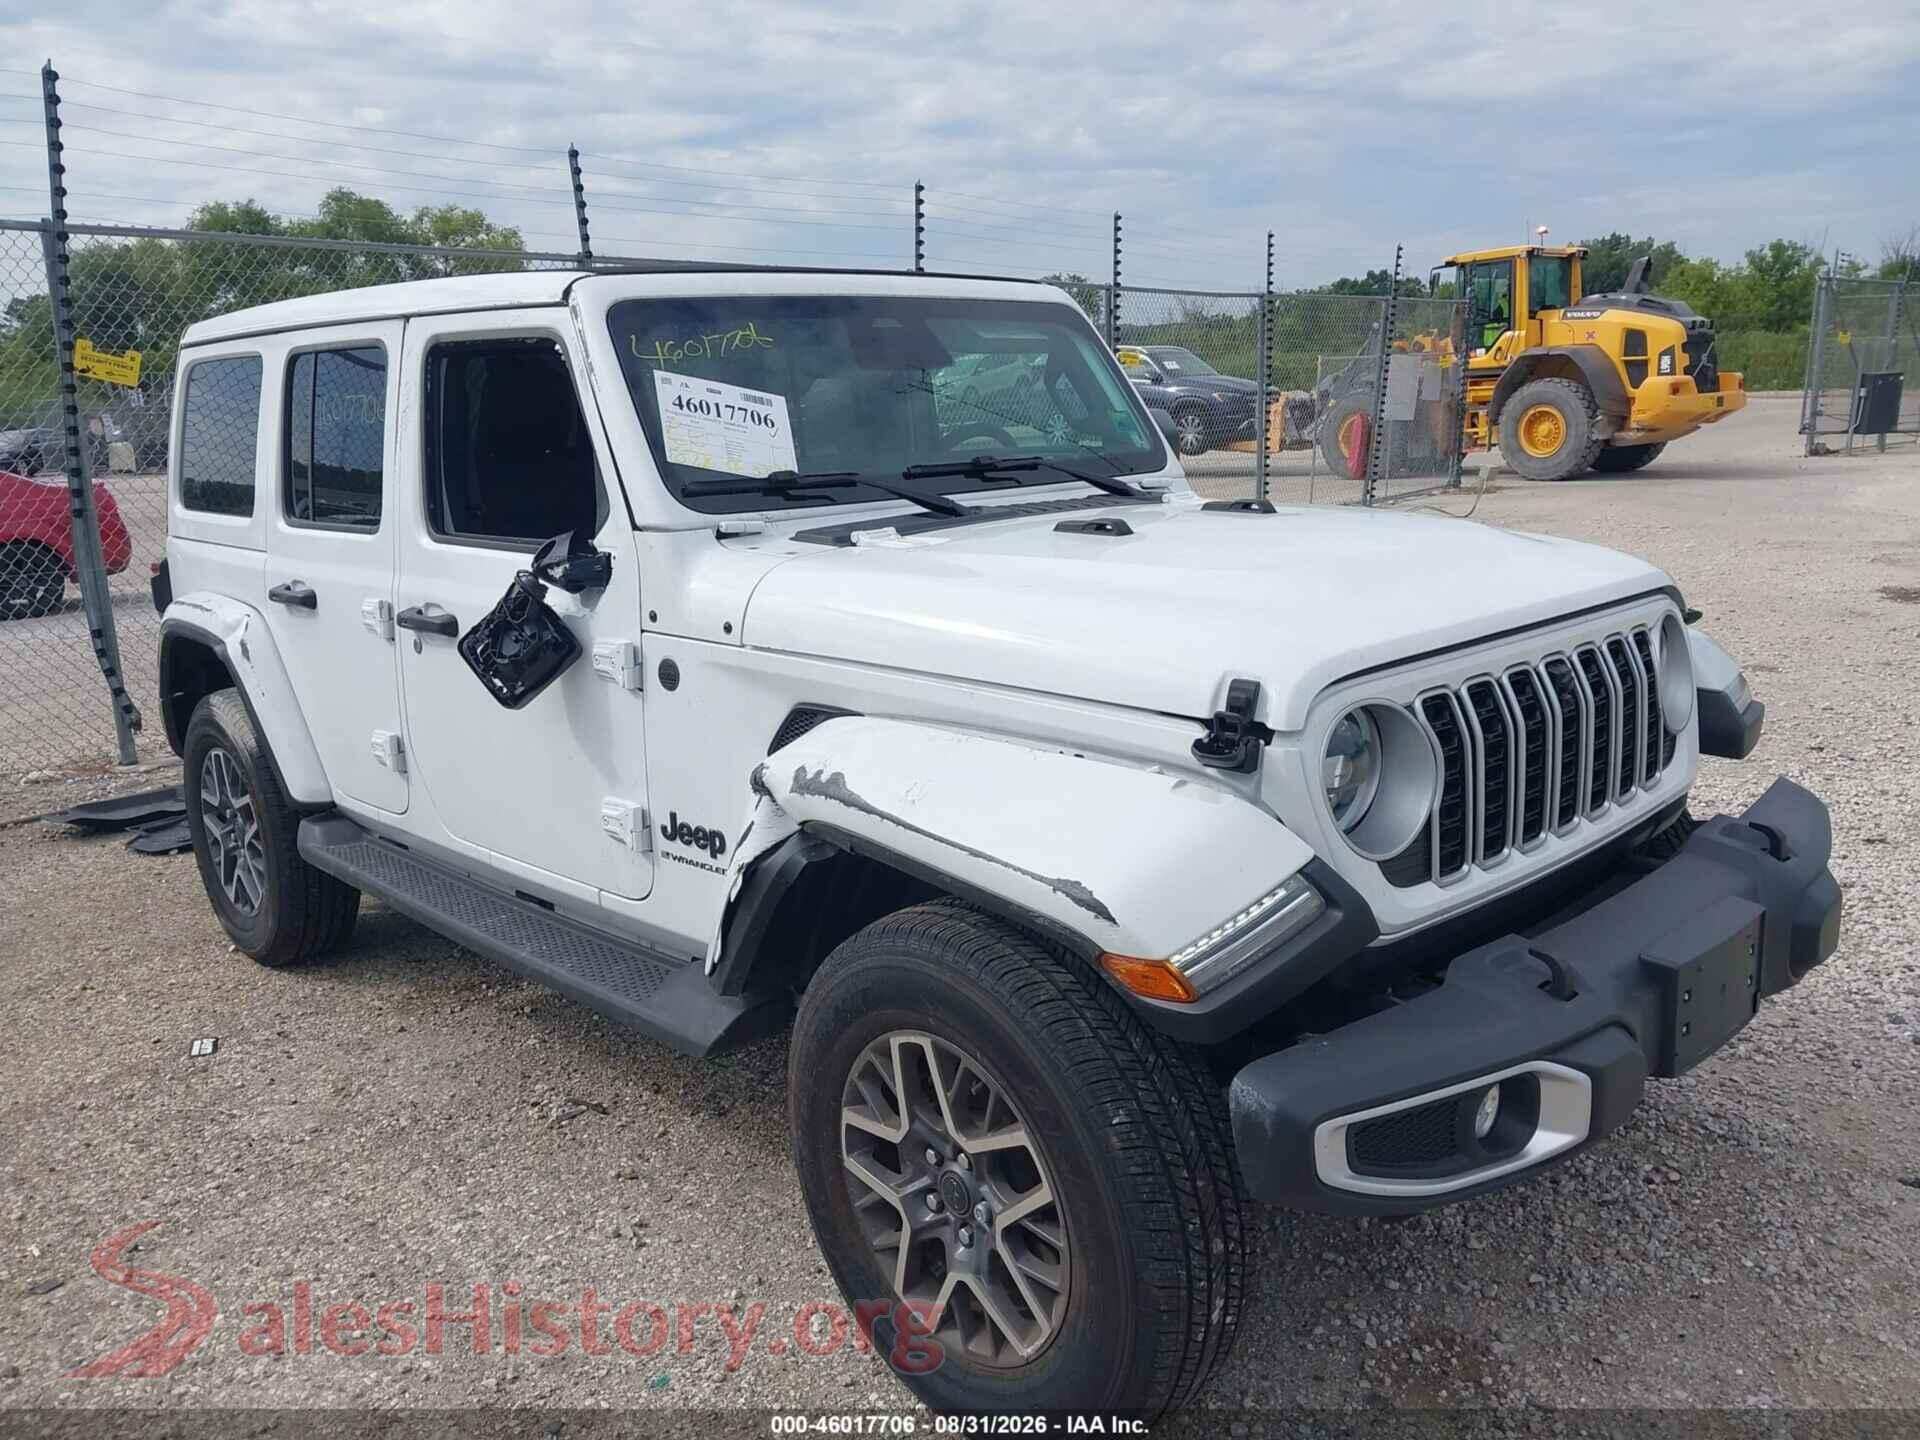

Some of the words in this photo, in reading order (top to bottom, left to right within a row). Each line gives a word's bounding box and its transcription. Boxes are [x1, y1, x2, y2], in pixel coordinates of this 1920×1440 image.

[672, 394, 775, 429] 46017706
[660, 811, 726, 859] Jeep
[671, 852, 728, 876] WRANGLER
